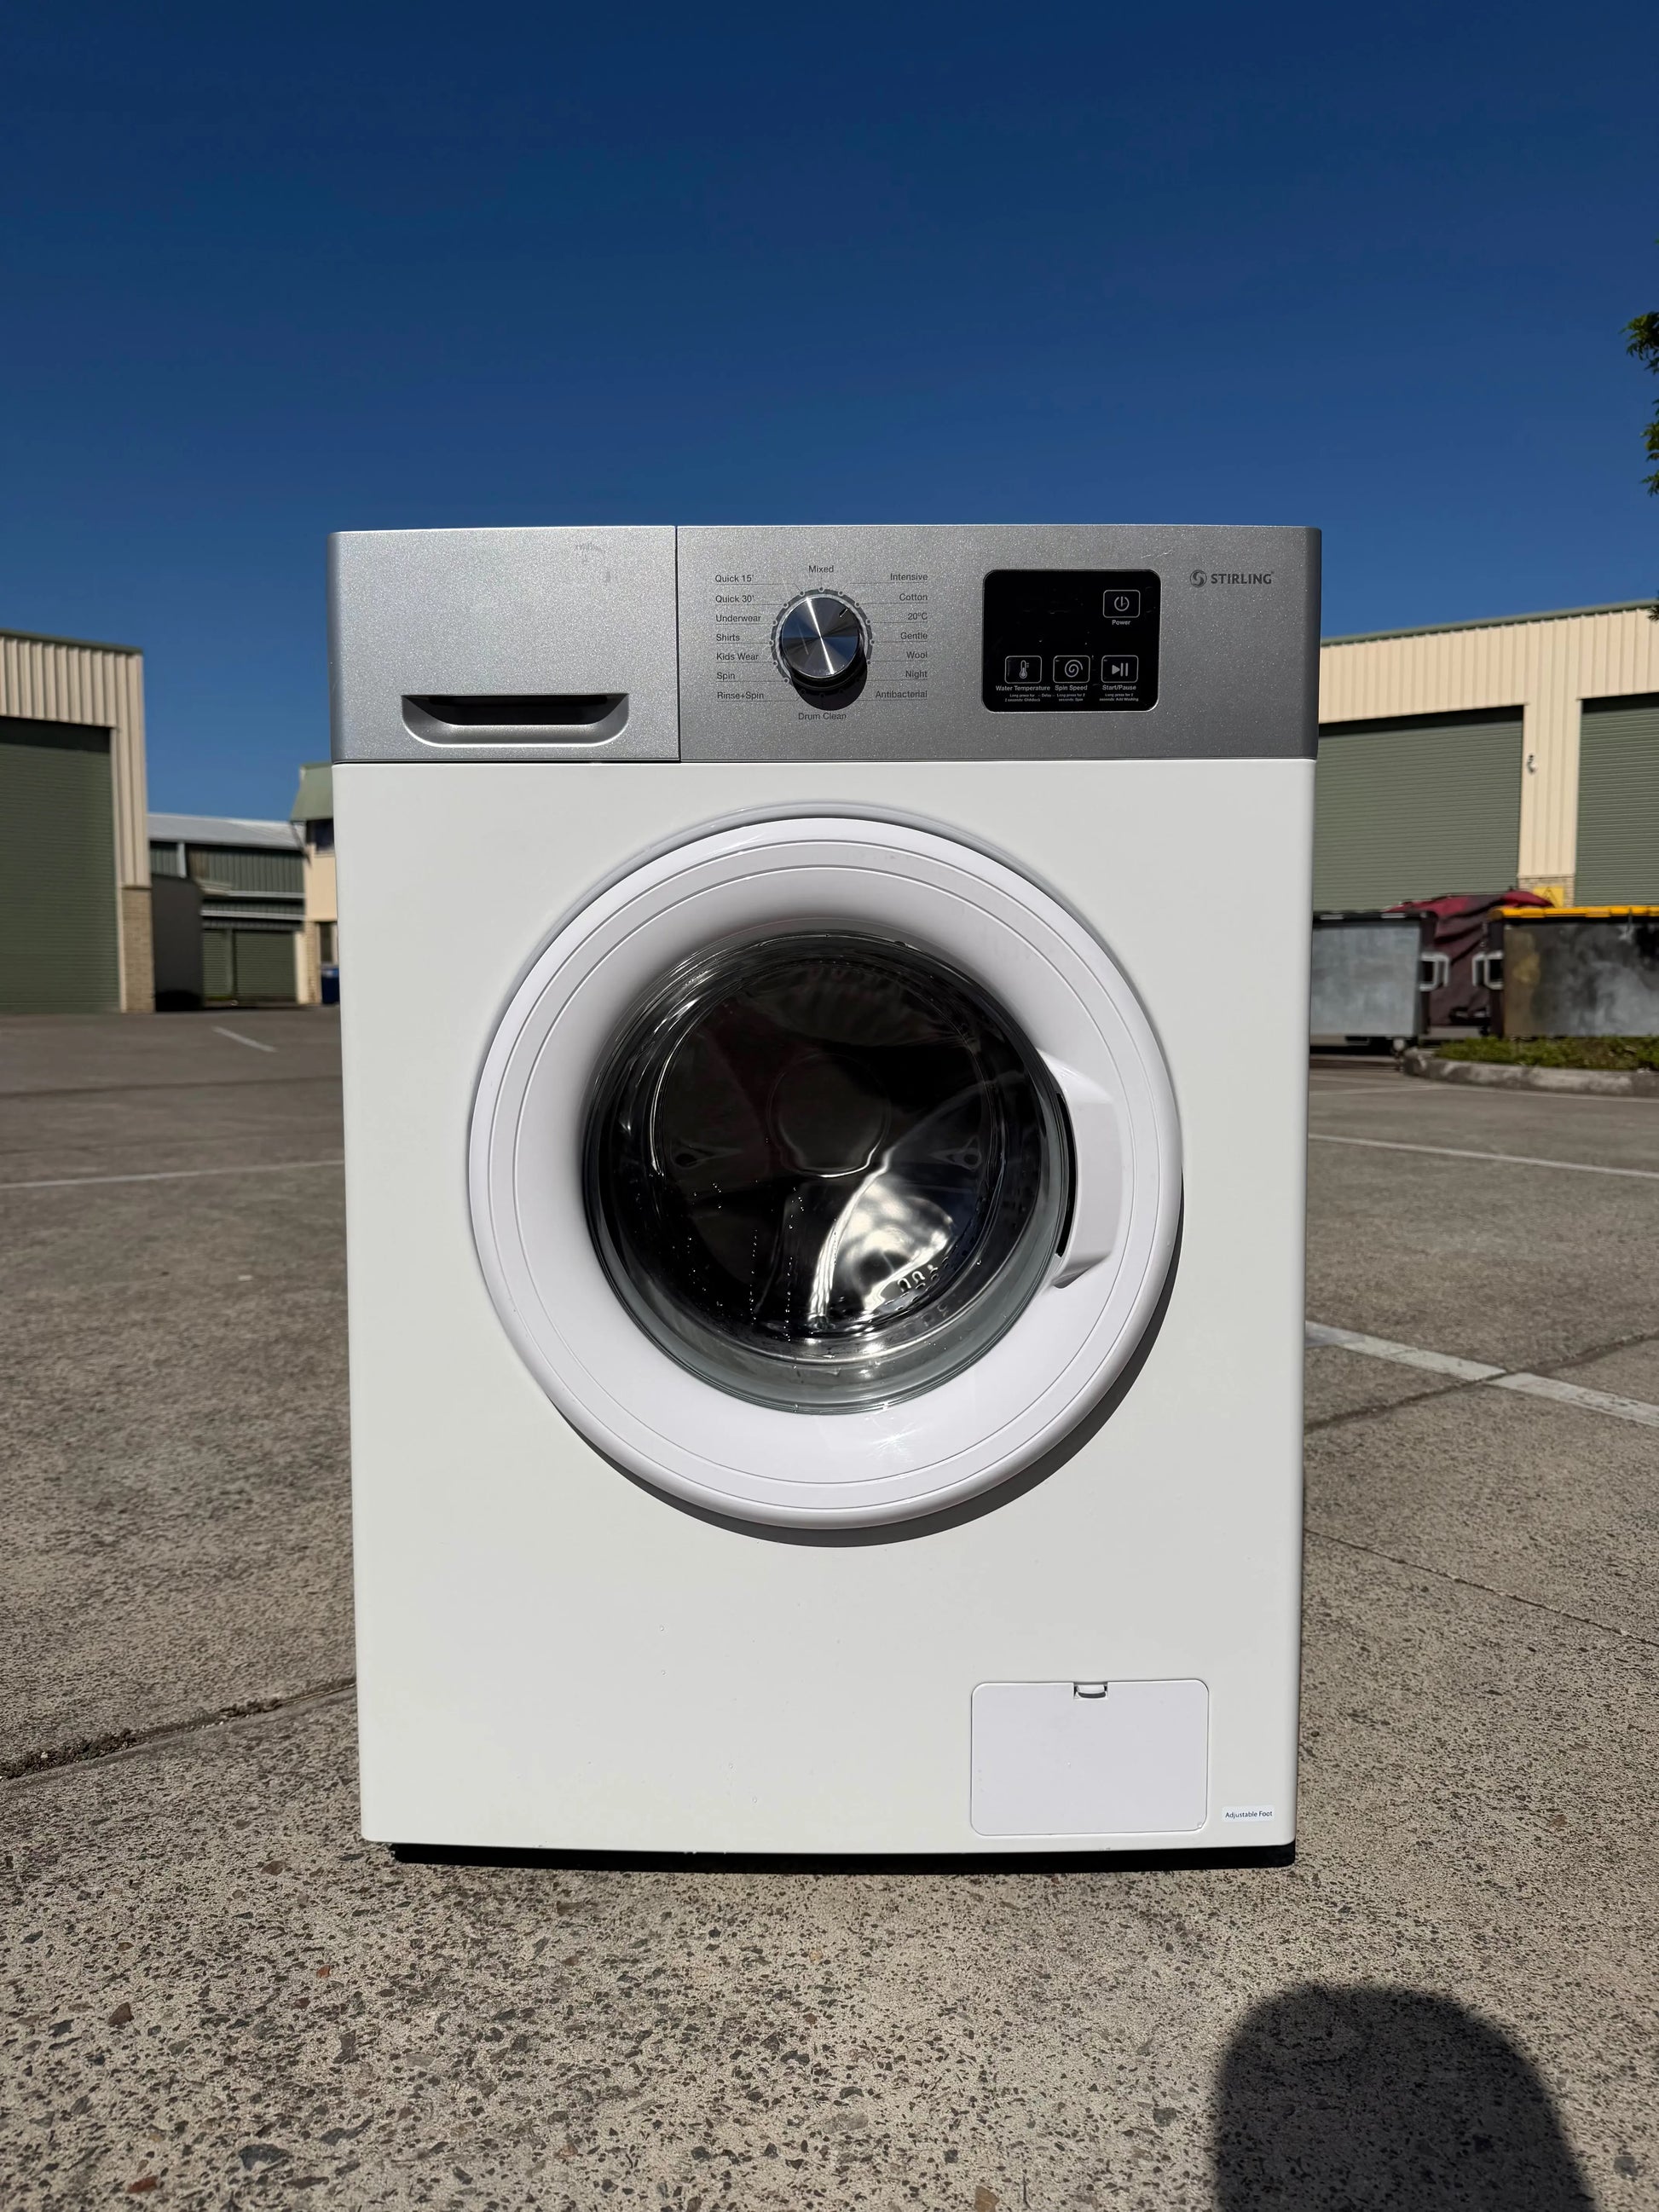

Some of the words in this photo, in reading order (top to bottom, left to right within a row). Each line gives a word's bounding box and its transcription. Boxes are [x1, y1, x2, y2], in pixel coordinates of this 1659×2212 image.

[1211, 573, 1272, 585] STIRLING
[716, 633, 740, 642] Shirts
[900, 632, 928, 640] Gentle
[716, 672, 736, 681] Spin
[717, 691, 765, 700] Rinse+Spin
[875, 690, 928, 699] Antibacterial
[823, 712, 847, 720] Clean
[1225, 1811, 1257, 1819] Adjustable
